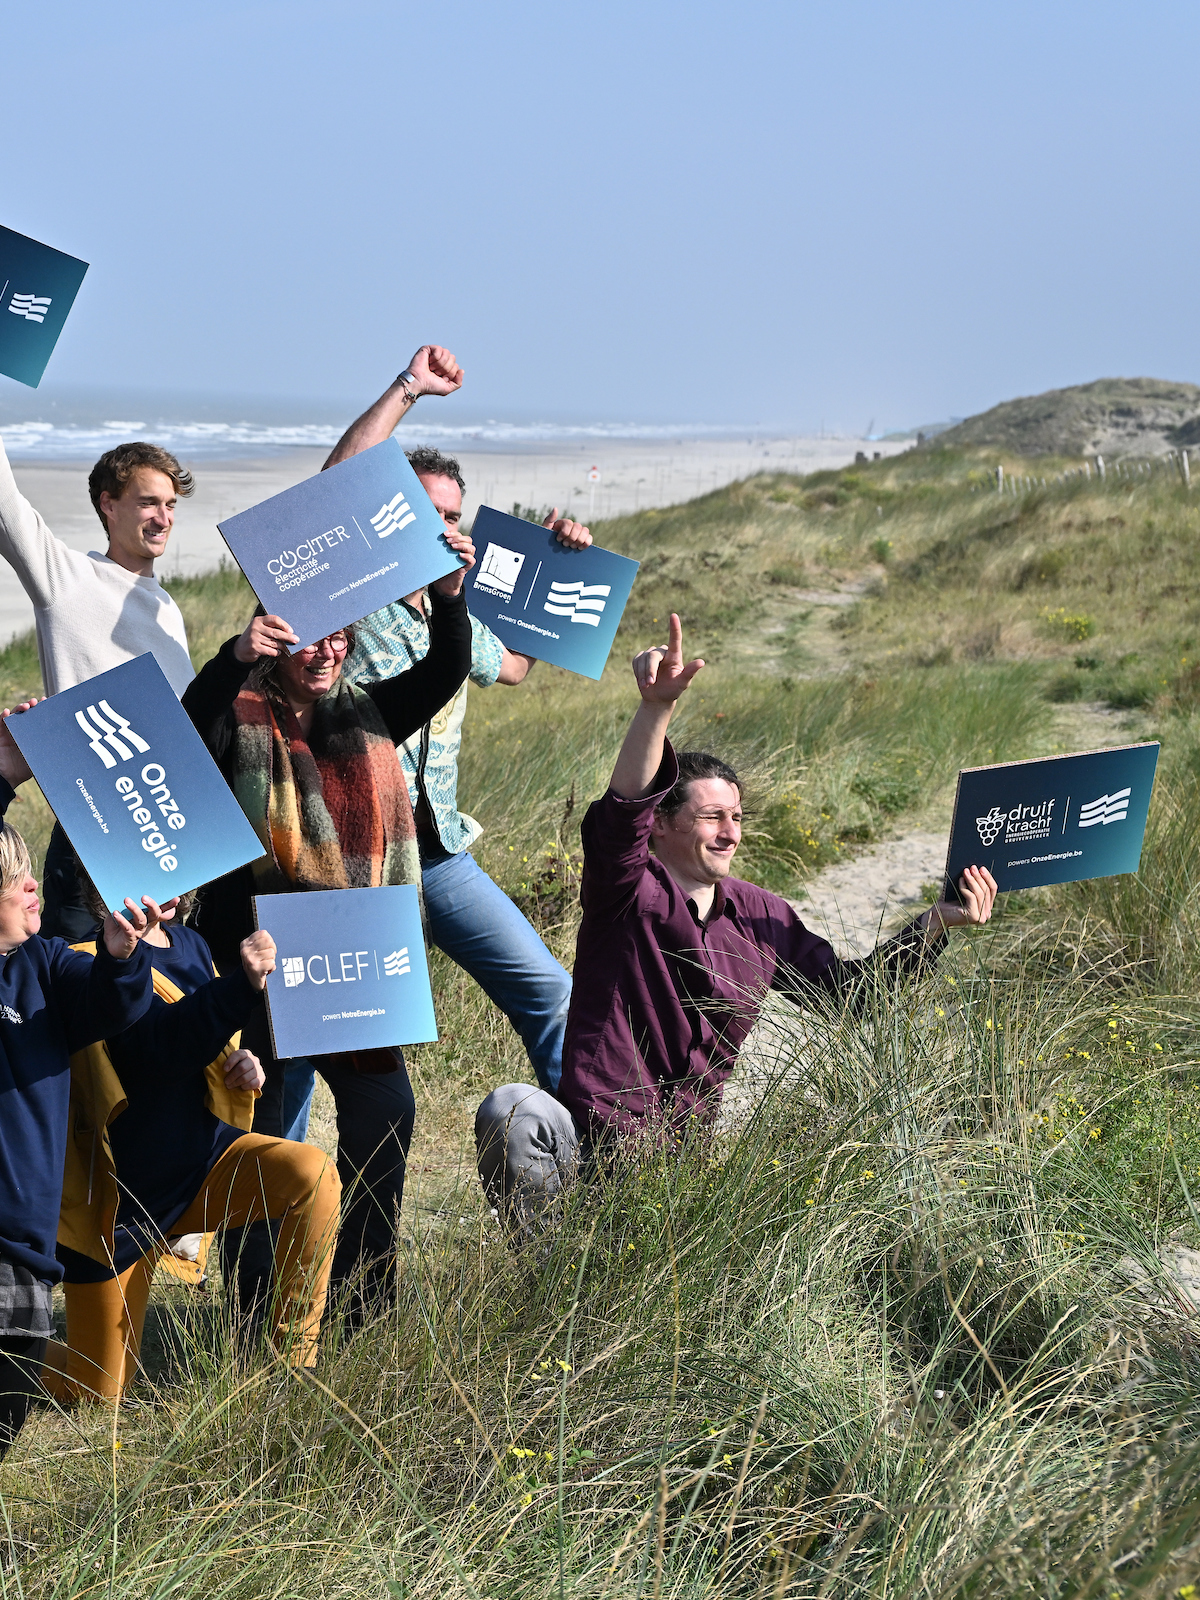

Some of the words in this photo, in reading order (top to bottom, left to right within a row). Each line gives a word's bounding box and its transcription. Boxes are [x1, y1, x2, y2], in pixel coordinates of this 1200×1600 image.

[266, 524, 351, 576] COCITER
[275, 557, 318, 585] électricité
[279, 562, 330, 592] coopérative
[328, 587, 351, 602] powers
[349, 561, 399, 590] NotreEnergie.be
[472, 581, 512, 601] BronsGroen
[497, 613, 518, 625] powers
[517, 619, 560, 640] OnzeEnergie.be
[75, 777, 110, 835] OnzeEnergie.be
[140, 762, 186, 831] Onze
[1008, 798, 1056, 821] druif
[115, 776, 179, 873] energie
[1005, 815, 1053, 834] kracht
[1007, 857, 1030, 868] powers
[1030, 850, 1083, 864] OnzeEnergie.be
[306, 950, 369, 985] CLEF
[322, 1012, 342, 1022] powers
[341, 1007, 386, 1019] NotreEnergie.be
